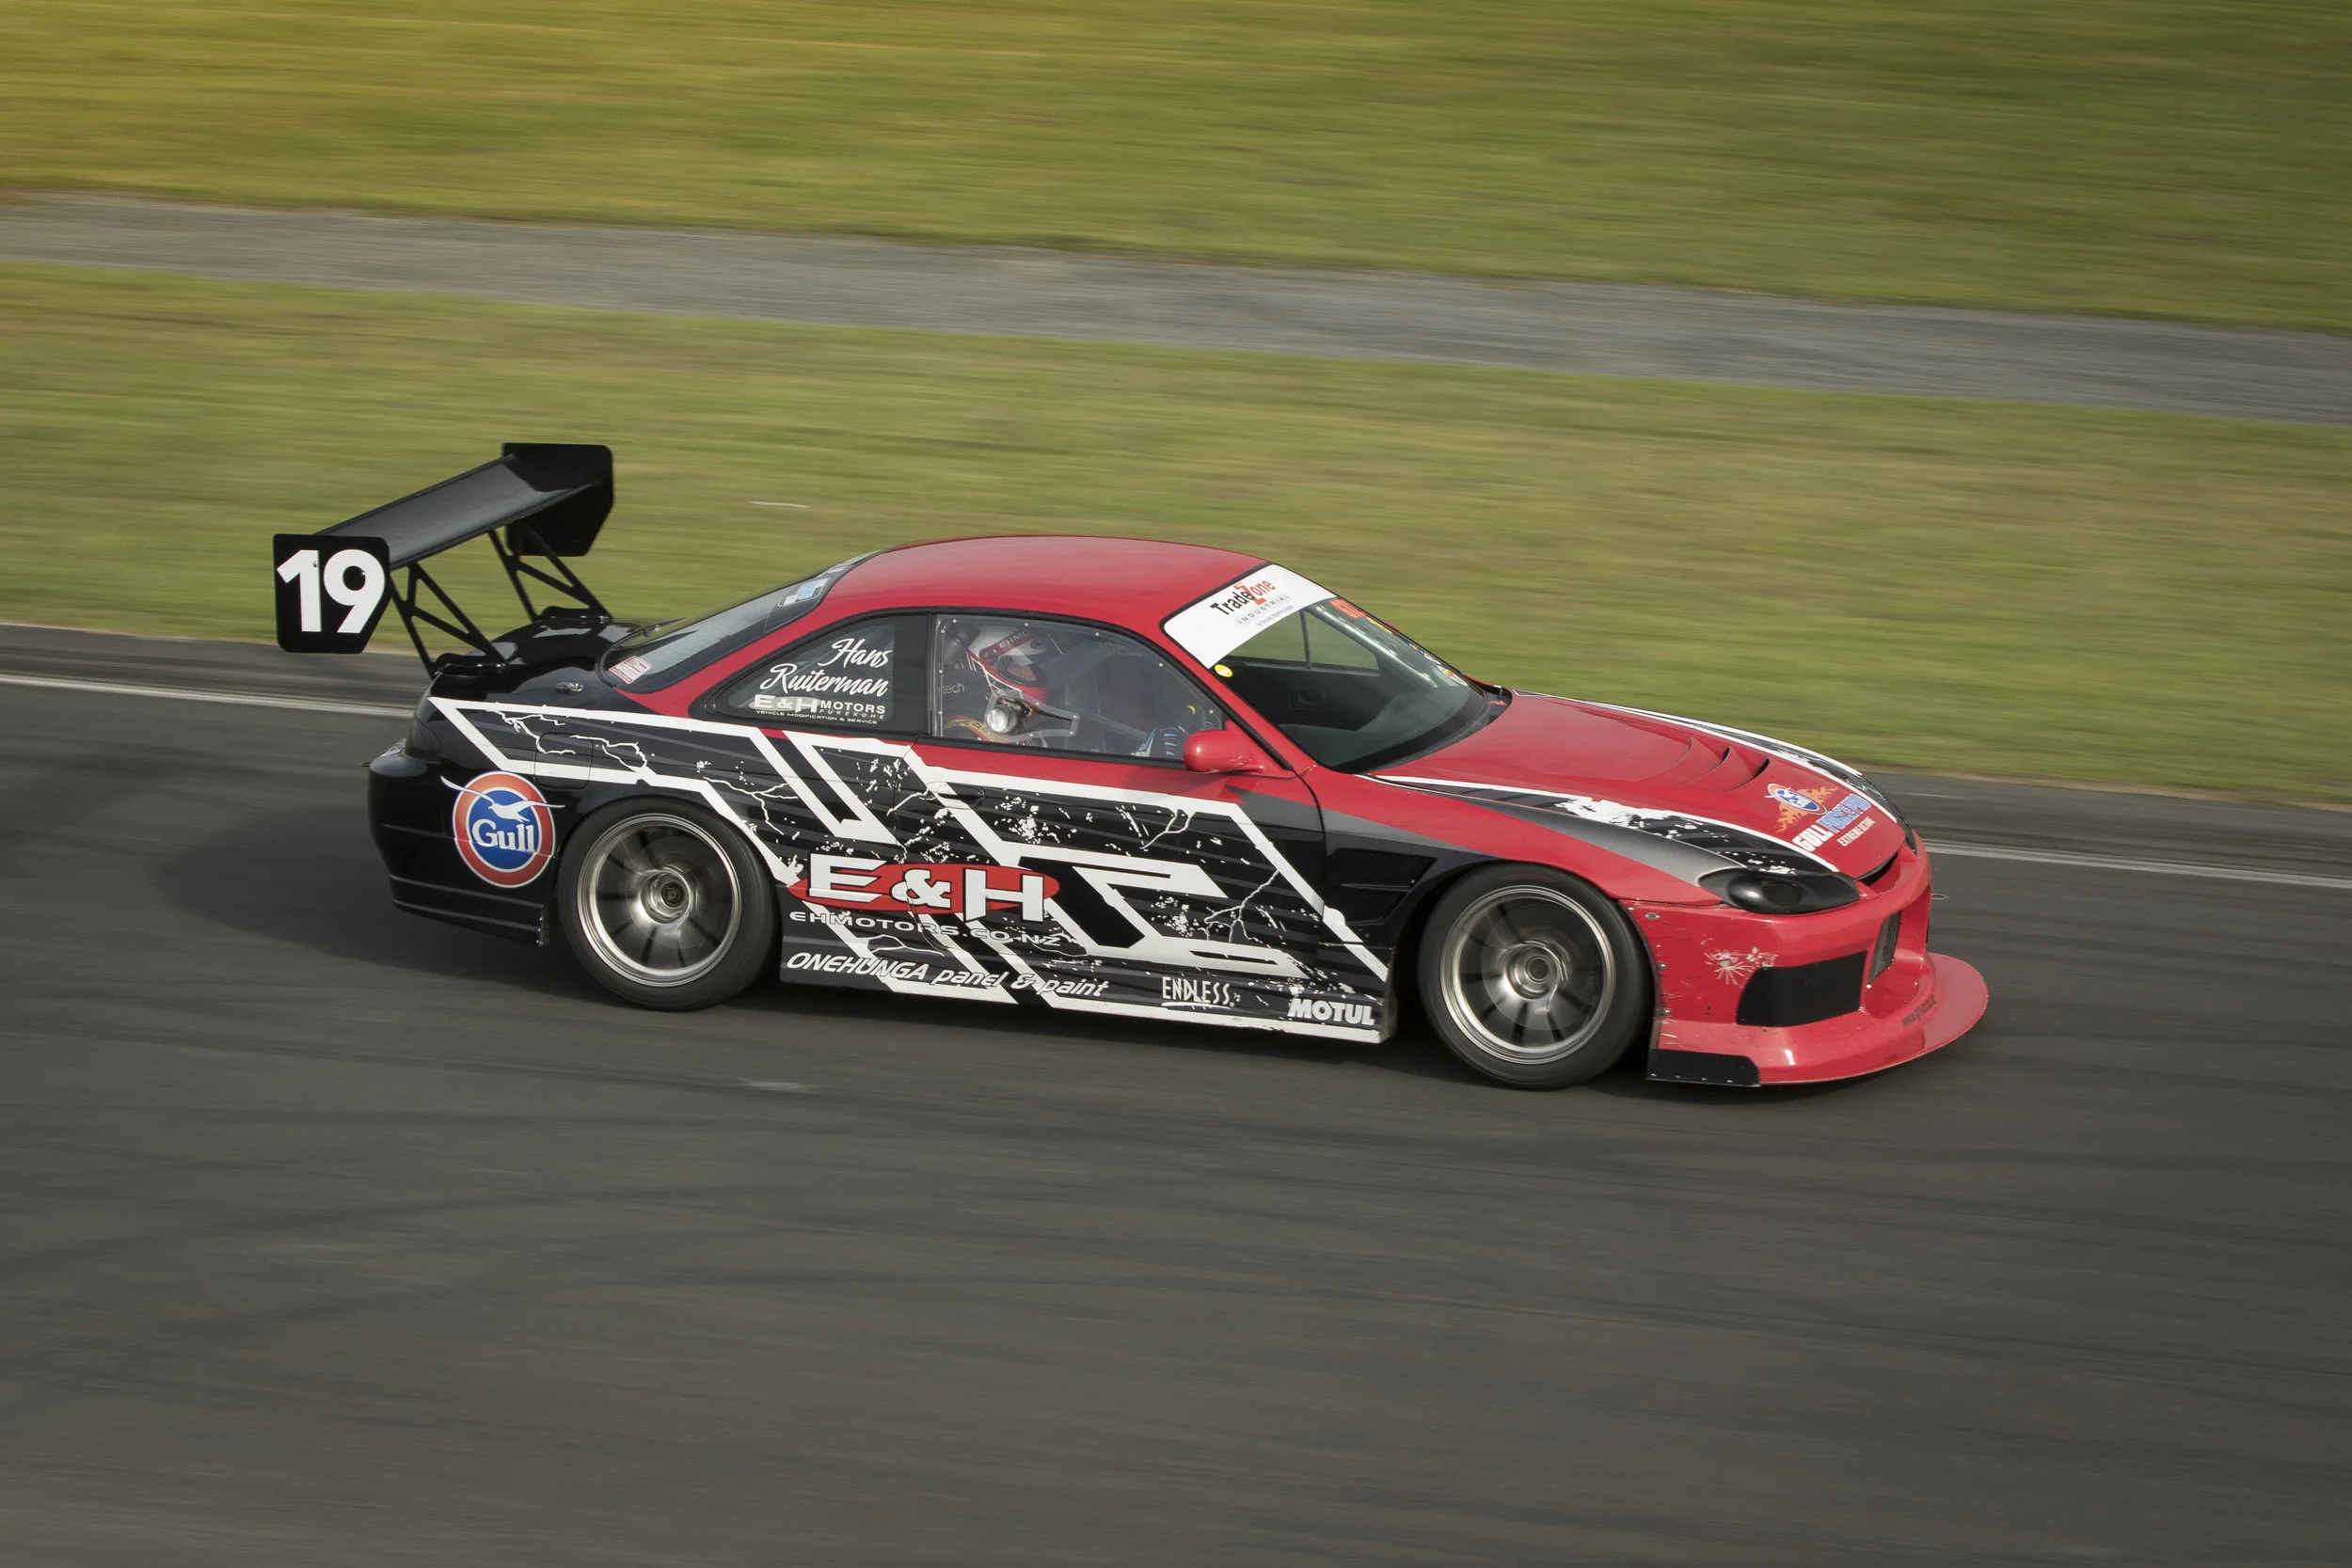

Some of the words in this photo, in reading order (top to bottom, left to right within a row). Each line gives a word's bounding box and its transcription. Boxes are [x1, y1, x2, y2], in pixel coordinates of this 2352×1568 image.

[277, 548, 385, 634] 19
[1209, 580, 1276, 615] TradeZone
[1237, 594, 1290, 625] INDUSTRIAL
[818, 638, 893, 669] Hans
[759, 663, 889, 698] Ruiterman
[754, 694, 818, 713] E&H
[820, 700, 886, 715] MOTORS
[787, 713, 838, 721] MODIFICATION
[819, 708, 884, 720] PUKEKOHE
[471, 818, 538, 854] Gull
[1791, 824, 1835, 852] GULL
[808, 852, 1045, 923] E&H
[787, 952, 930, 981] ONEHUNGA
[931, 966, 1008, 989] panel
[1011, 973, 1038, 989] &
[1036, 975, 1110, 997] paint
[1162, 976, 1231, 1006] ENDLESS
[1287, 998, 1375, 1026] MOTUL
